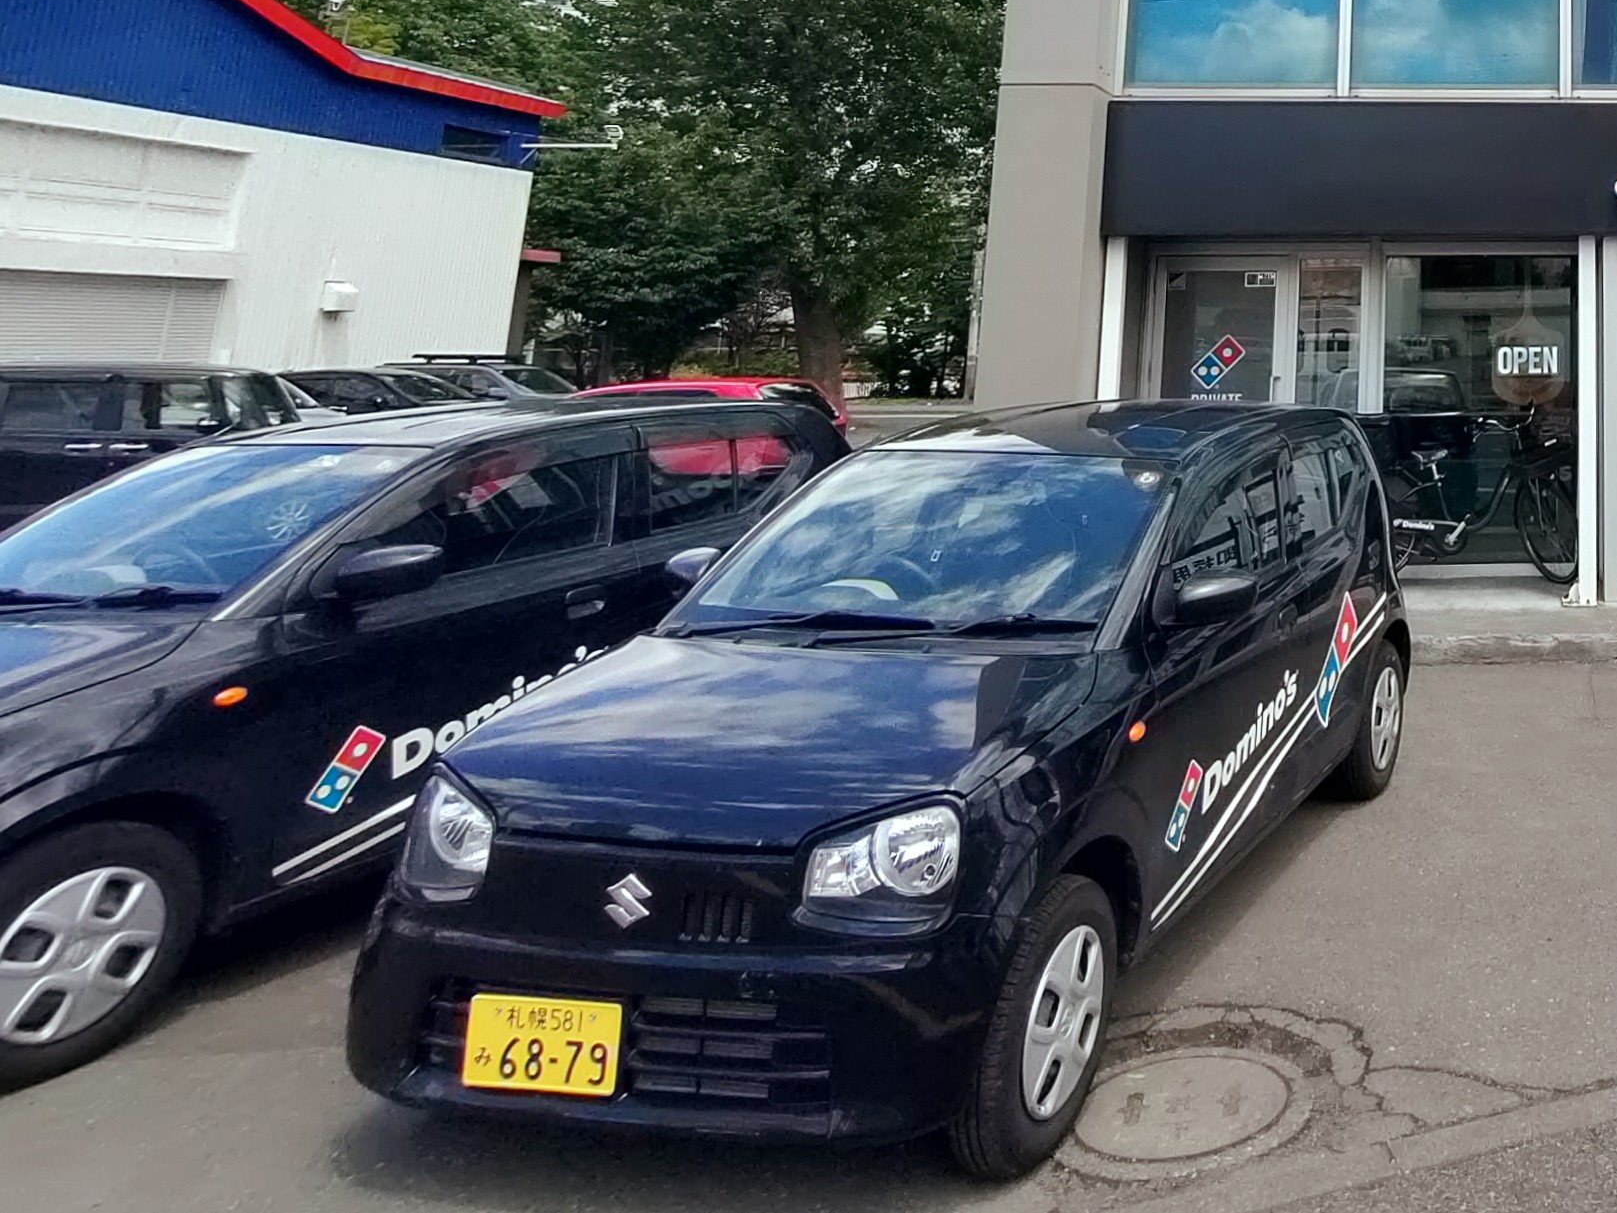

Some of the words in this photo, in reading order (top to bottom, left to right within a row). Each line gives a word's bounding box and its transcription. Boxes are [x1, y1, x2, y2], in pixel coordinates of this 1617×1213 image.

[1498, 346, 1558, 374] OPEN
[1201, 669, 1299, 815] Domino's
[474, 1047, 492, 1066] み
[500, 1037, 608, 1086] 68-79
